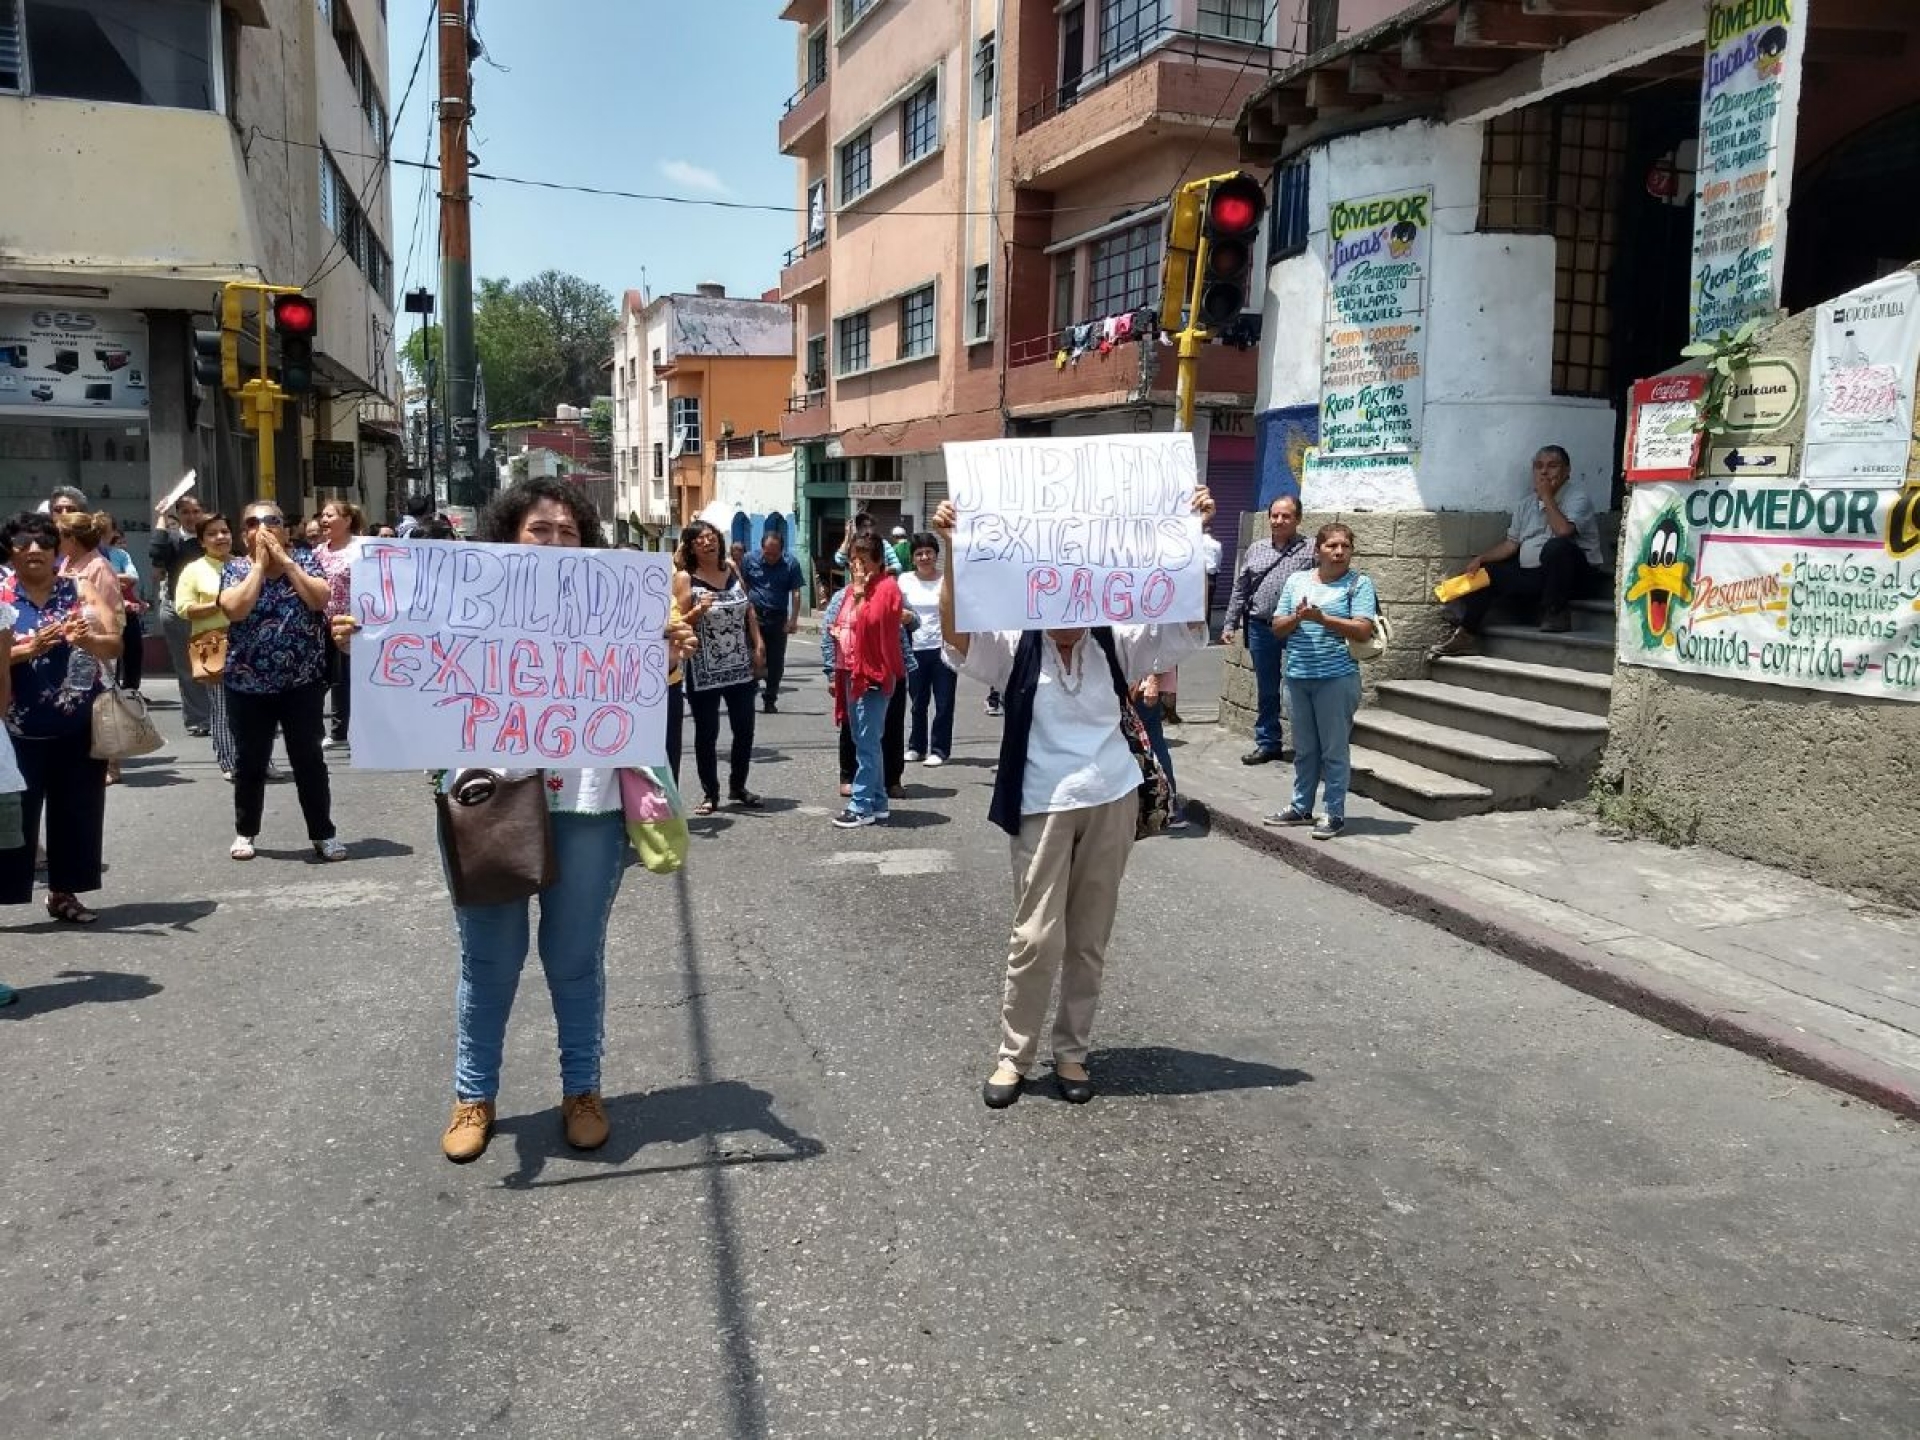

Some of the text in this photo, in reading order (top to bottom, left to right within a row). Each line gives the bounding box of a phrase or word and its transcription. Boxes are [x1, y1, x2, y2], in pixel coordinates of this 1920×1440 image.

[1709, 0, 1790, 49] COMEDOR
[1330, 196, 1428, 241] COMEDOR
[1337, 293, 1398, 311] ENCHILADAS
[1376, 278, 1407, 292] GUSTO
[1343, 307, 1403, 323] CHILAQUILES
[1358, 384, 1403, 409] TORTAS
[955, 440, 1195, 518] JUBILADOS
[1685, 489, 1879, 534] COMEDOR
[965, 514, 1194, 571] EXIGIMOS
[358, 544, 669, 640] JUBILADOS
[1027, 566, 1175, 622] PAGO
[1791, 580, 1899, 615] Chilaquiles
[370, 631, 669, 707] EXIGIMOS
[432, 692, 634, 759] PAGO
